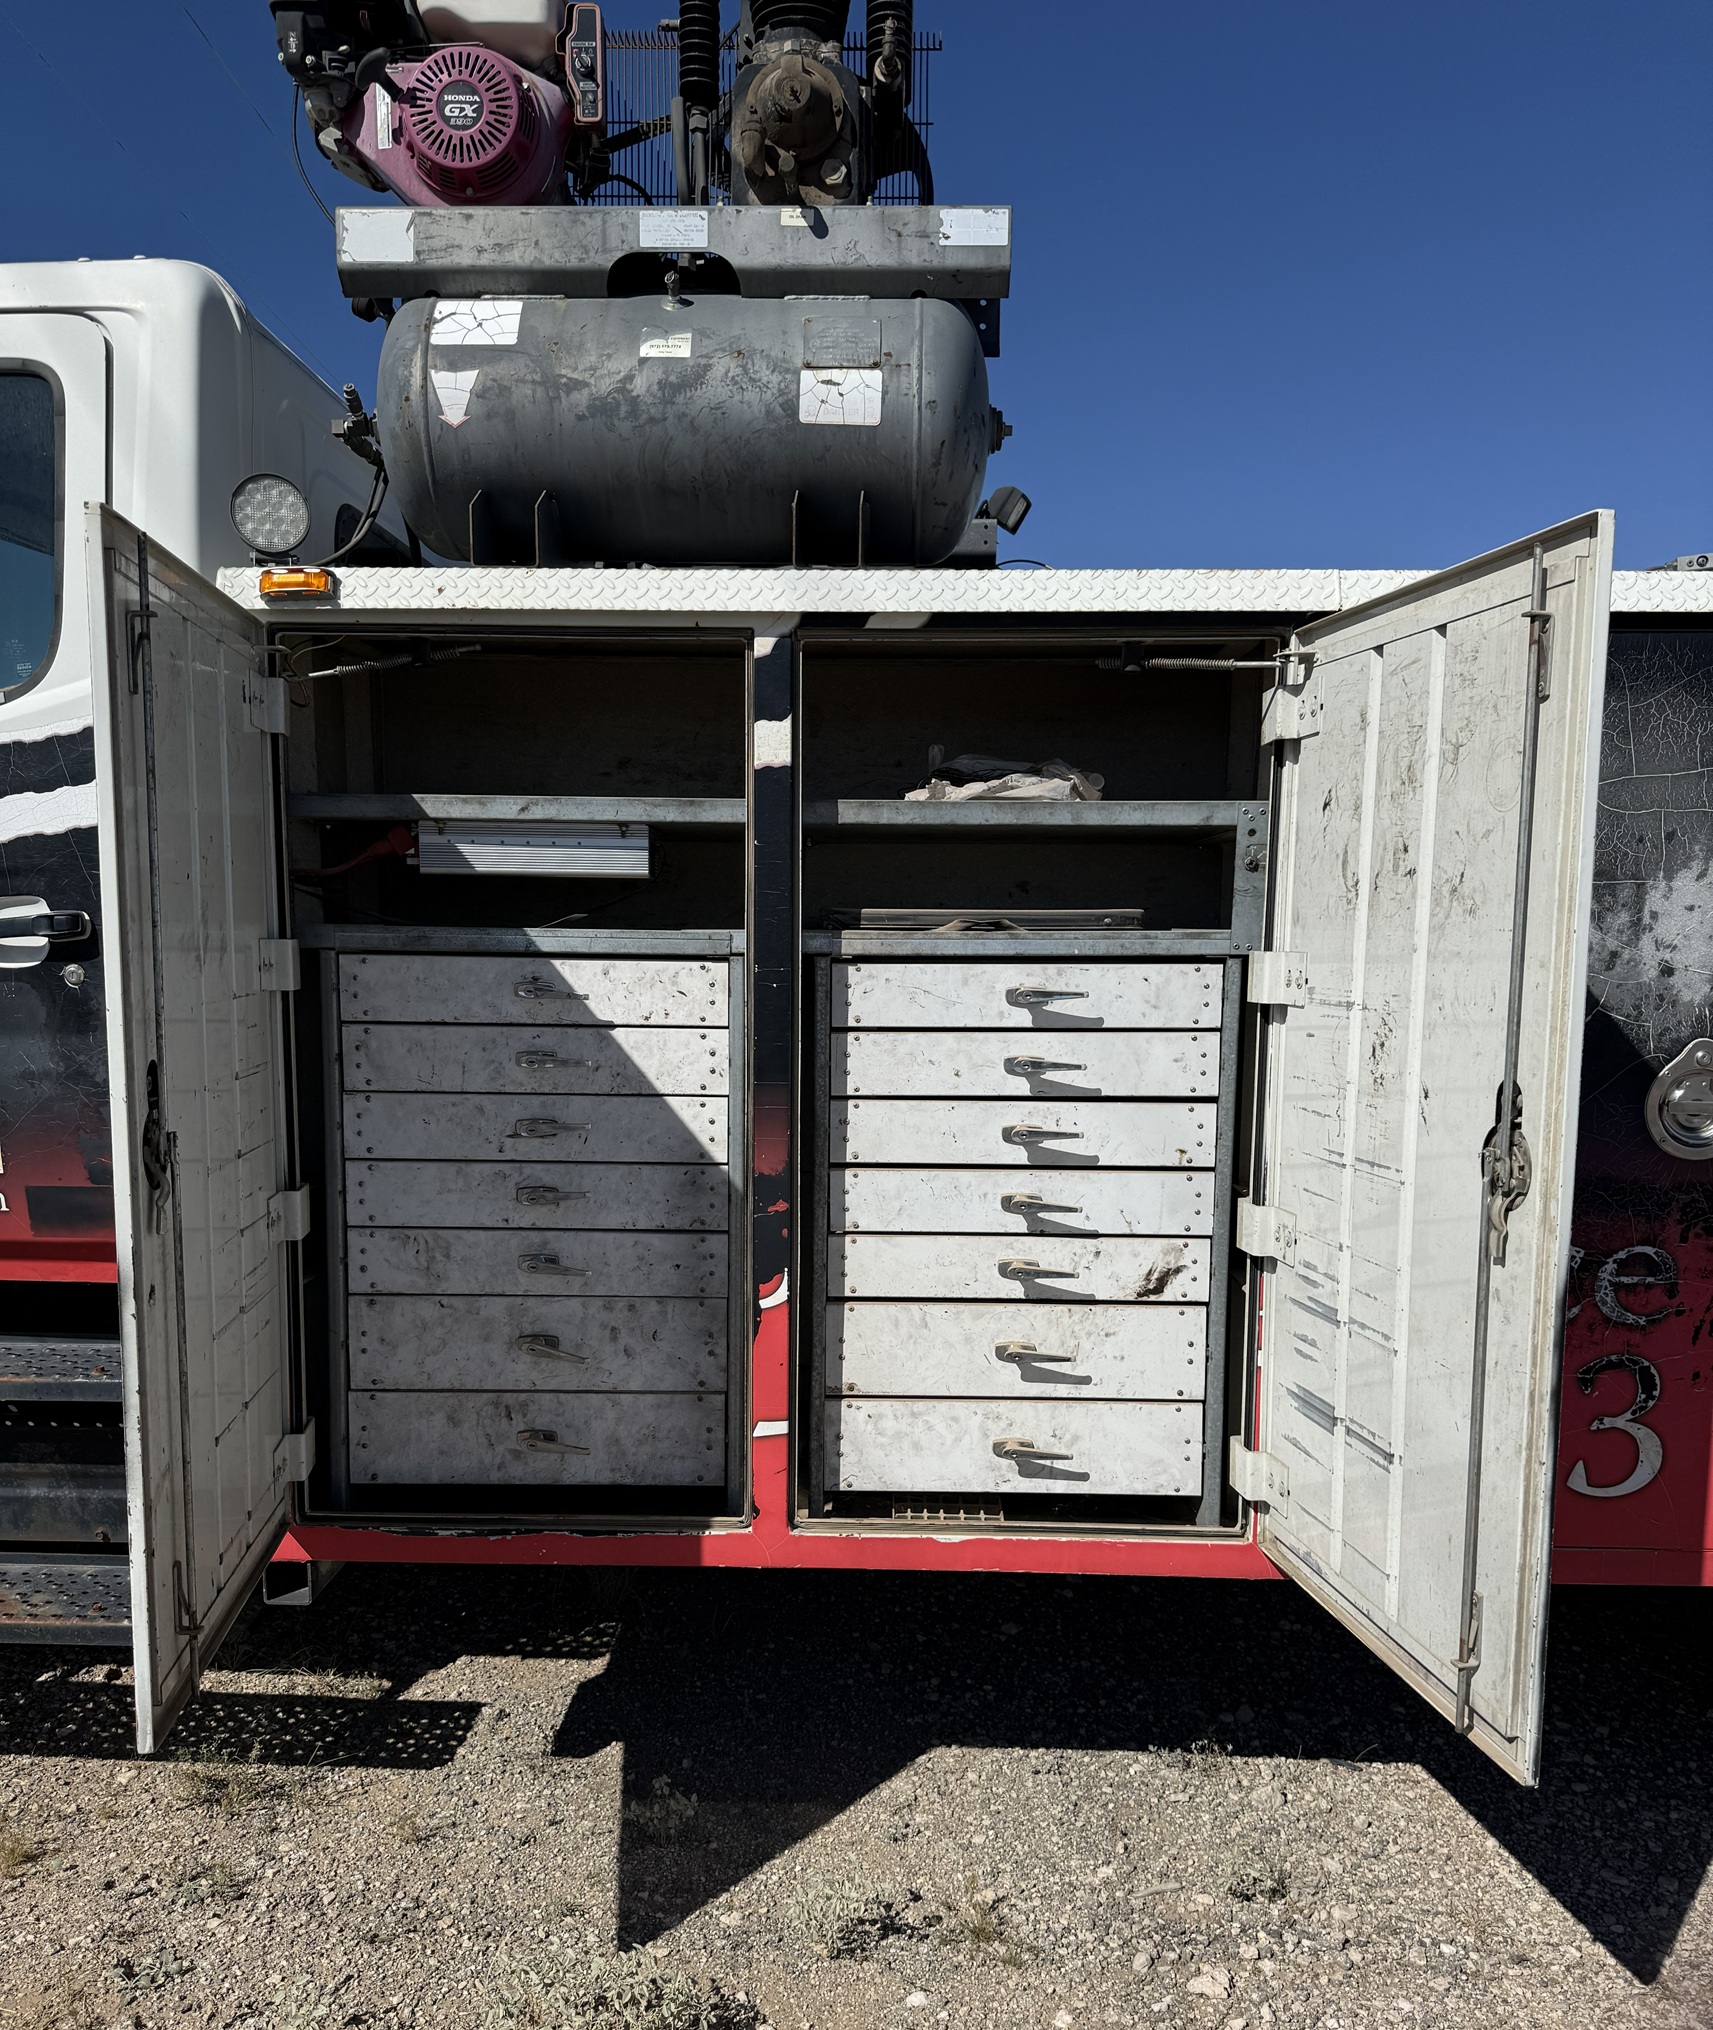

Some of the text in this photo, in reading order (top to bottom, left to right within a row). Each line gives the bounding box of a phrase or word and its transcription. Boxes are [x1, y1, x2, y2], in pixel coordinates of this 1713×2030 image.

[443, 94, 481, 102] HONDA
[444, 103, 479, 117] GX
[823, 407, 860, 416] DANER
[1566, 1354, 1664, 1497] 3
